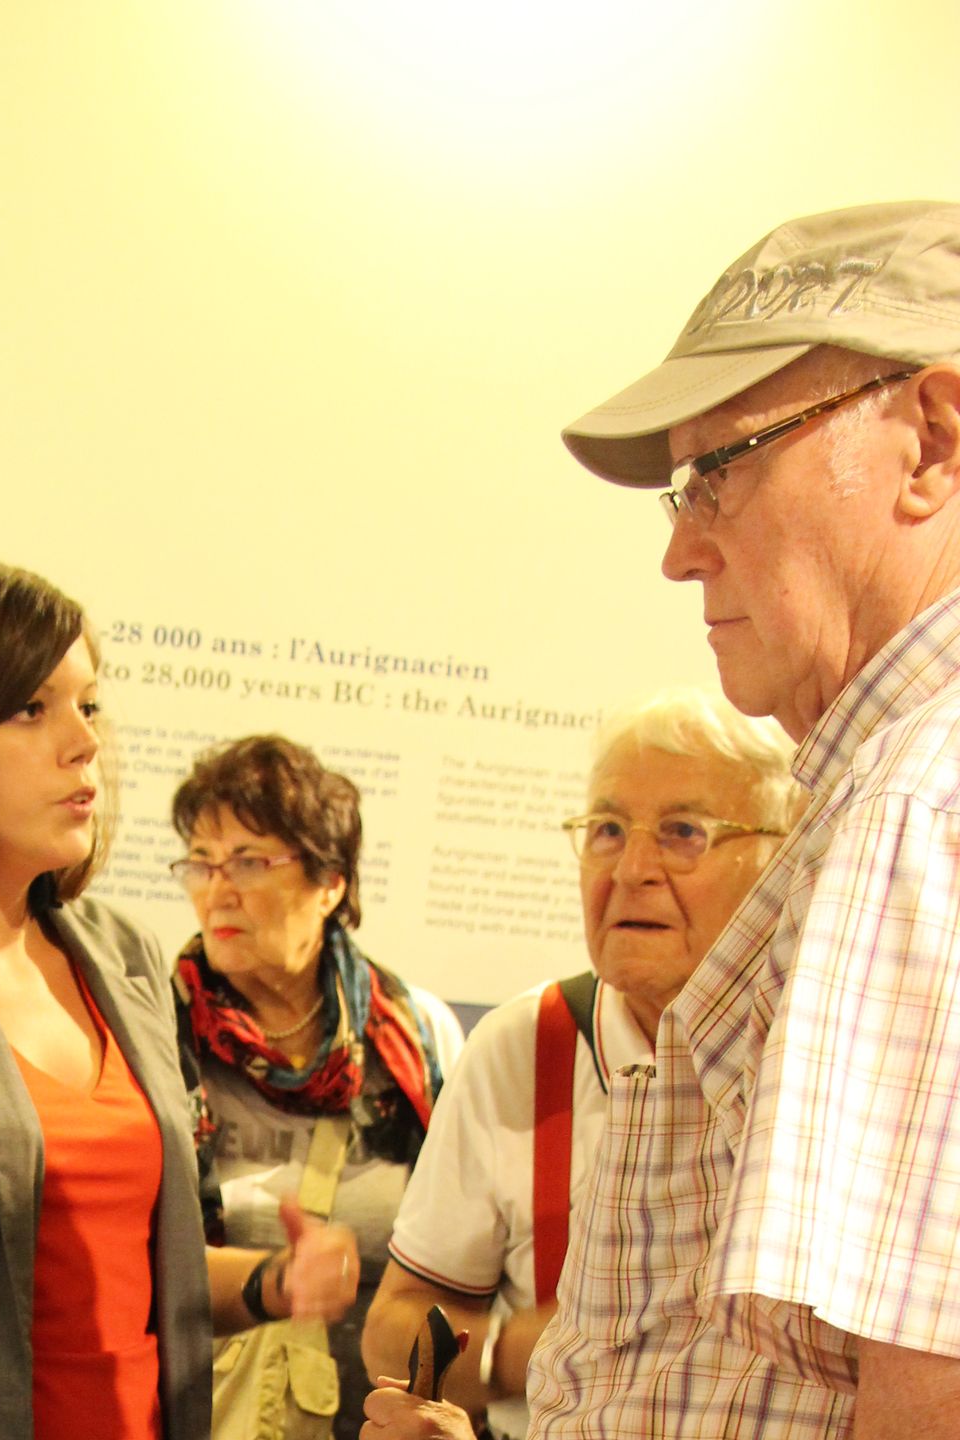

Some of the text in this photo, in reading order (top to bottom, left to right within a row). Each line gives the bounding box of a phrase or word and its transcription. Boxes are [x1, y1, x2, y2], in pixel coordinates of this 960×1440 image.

[153, 625, 202, 650] 000
[212, 636, 263, 656] ans
[289, 637, 490, 681] l'Aurignacien
[141, 661, 232, 690] 28,000
[239, 677, 322, 700] years
[334, 679, 376, 705] BC
[402, 688, 448, 715] the
[457, 695, 604, 729] Aurignaci
